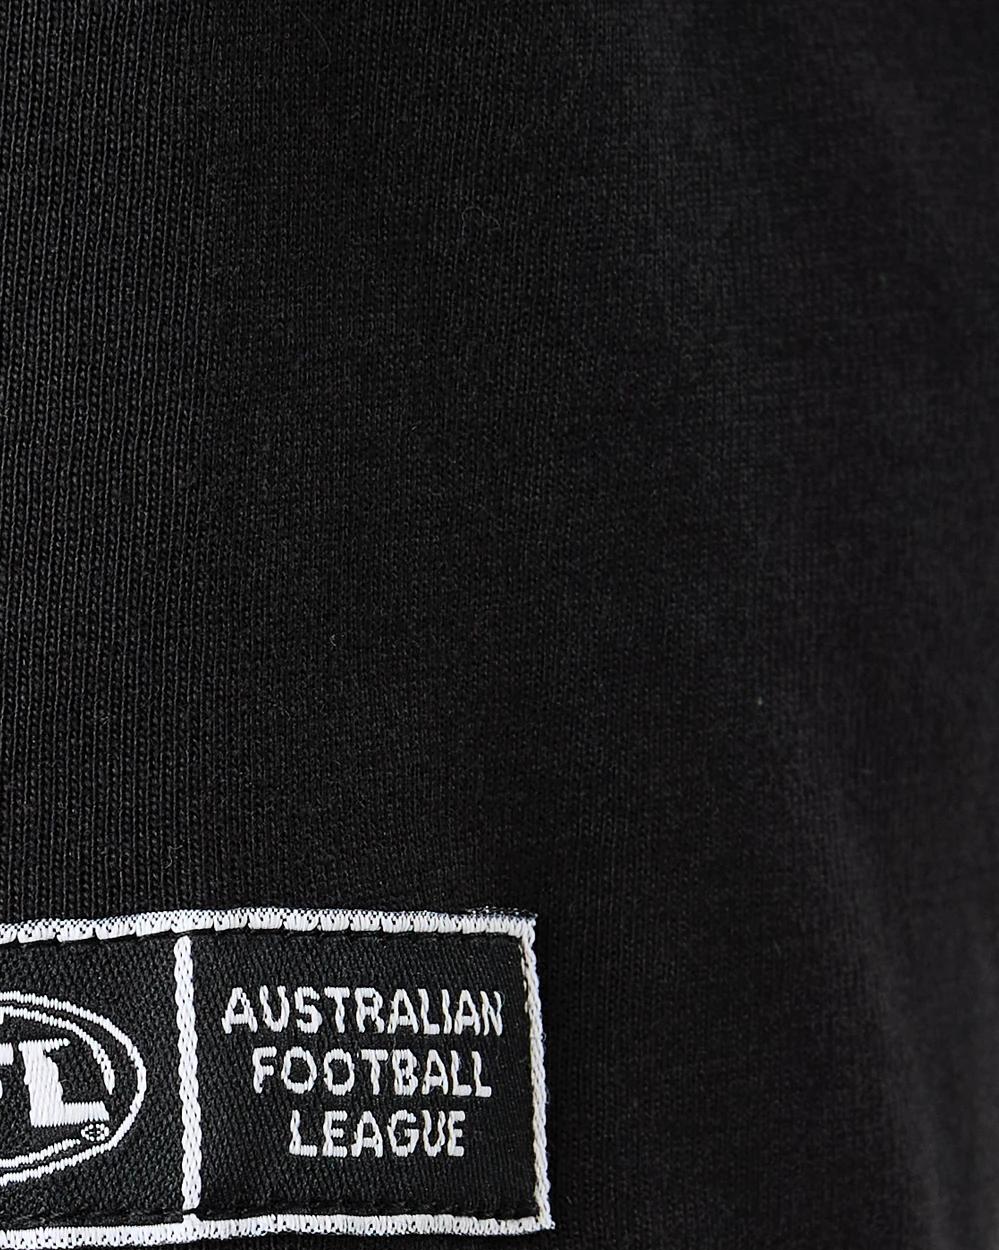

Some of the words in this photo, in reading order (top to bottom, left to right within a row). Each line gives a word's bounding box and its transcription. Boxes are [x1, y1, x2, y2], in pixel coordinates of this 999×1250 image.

[221, 985, 503, 1036] AUSTRALIAN
[252, 1046, 492, 1098] FOOTBALL
[289, 1109, 466, 1158] LEAGUE
